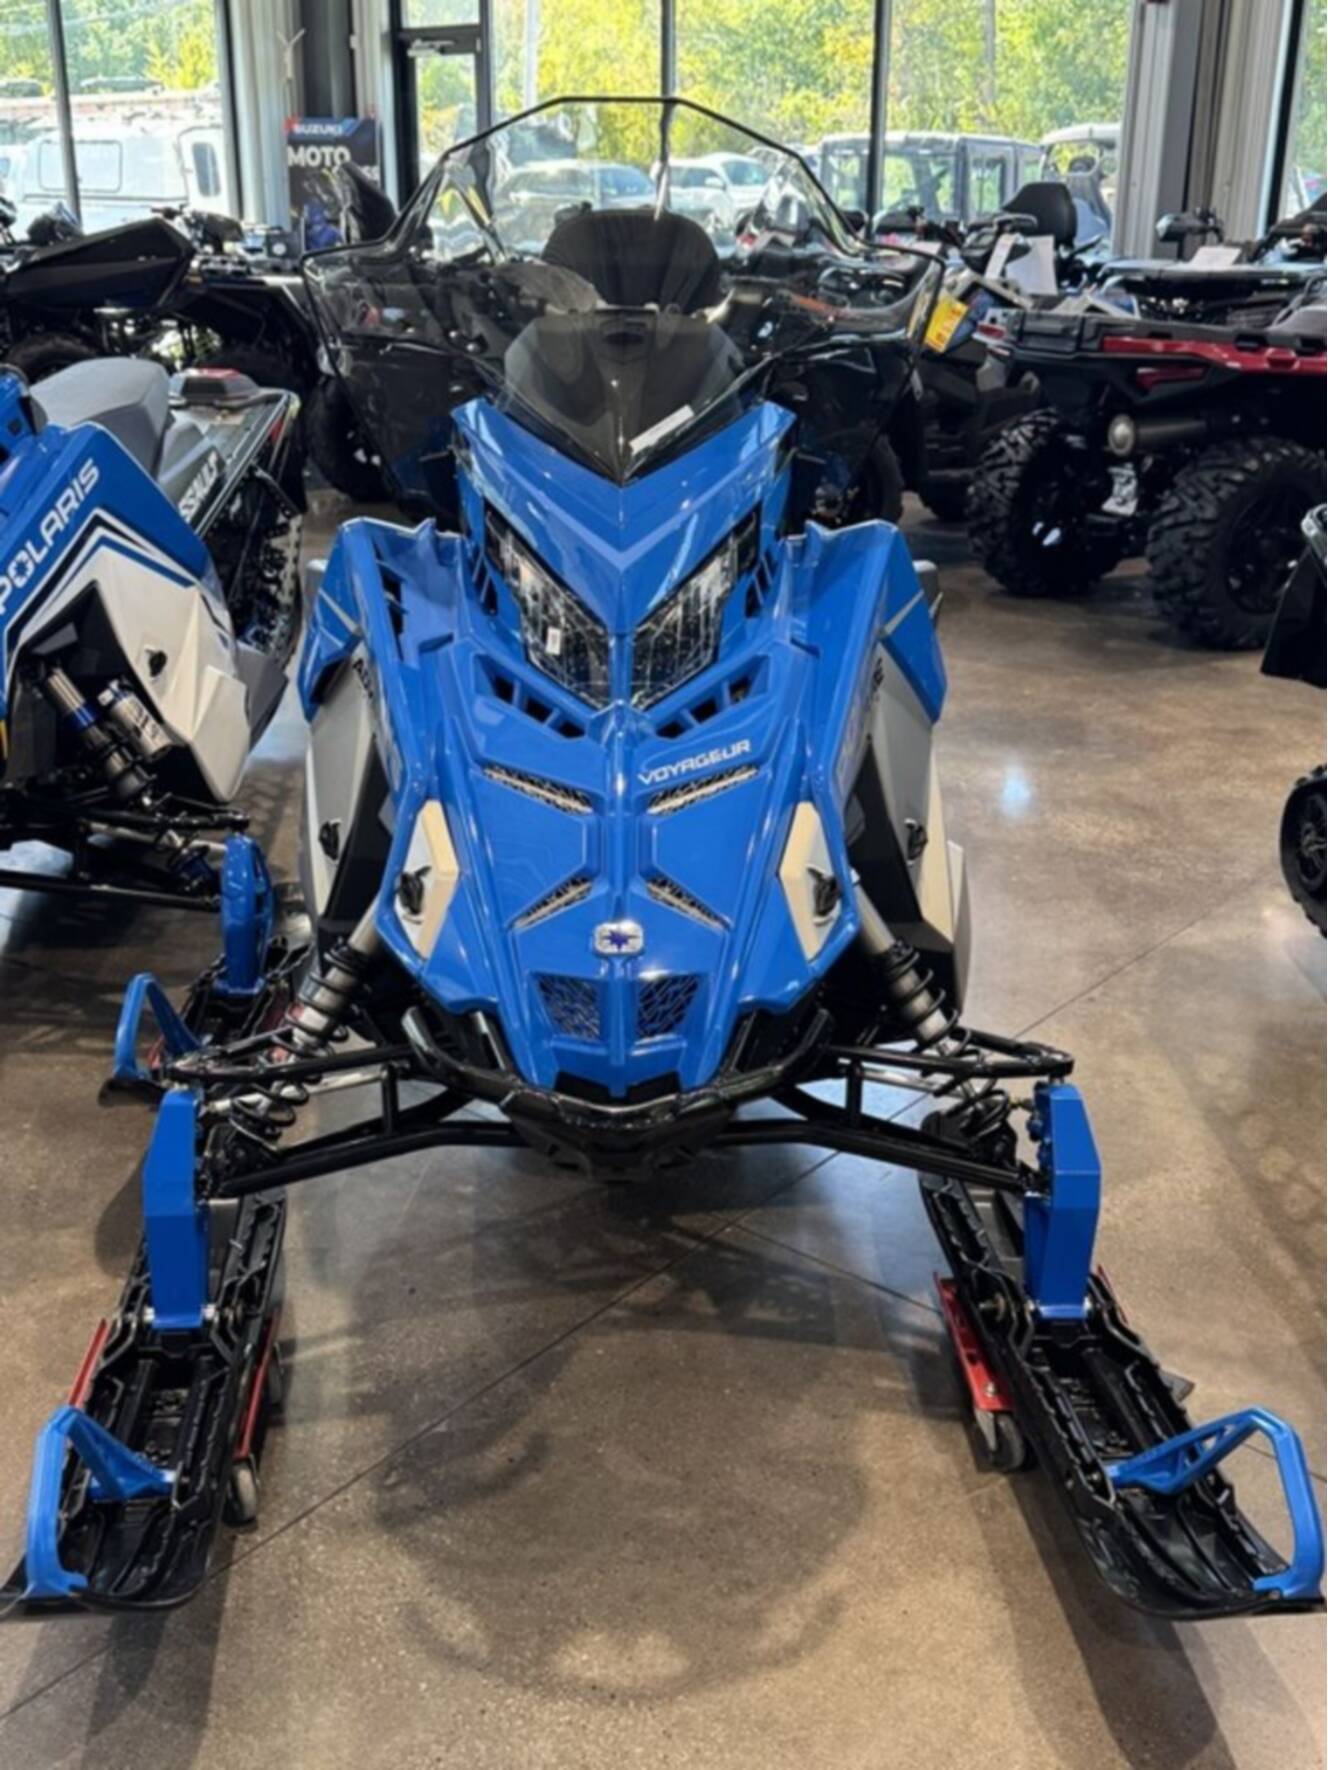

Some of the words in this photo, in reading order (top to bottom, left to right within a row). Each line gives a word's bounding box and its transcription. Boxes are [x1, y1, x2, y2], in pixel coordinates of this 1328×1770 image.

[293, 123, 343, 135] SUZUKI
[287, 145, 351, 168] MOTO
[0, 457, 100, 615] POLARIS
[637, 739, 752, 785] VOYAGEUR
